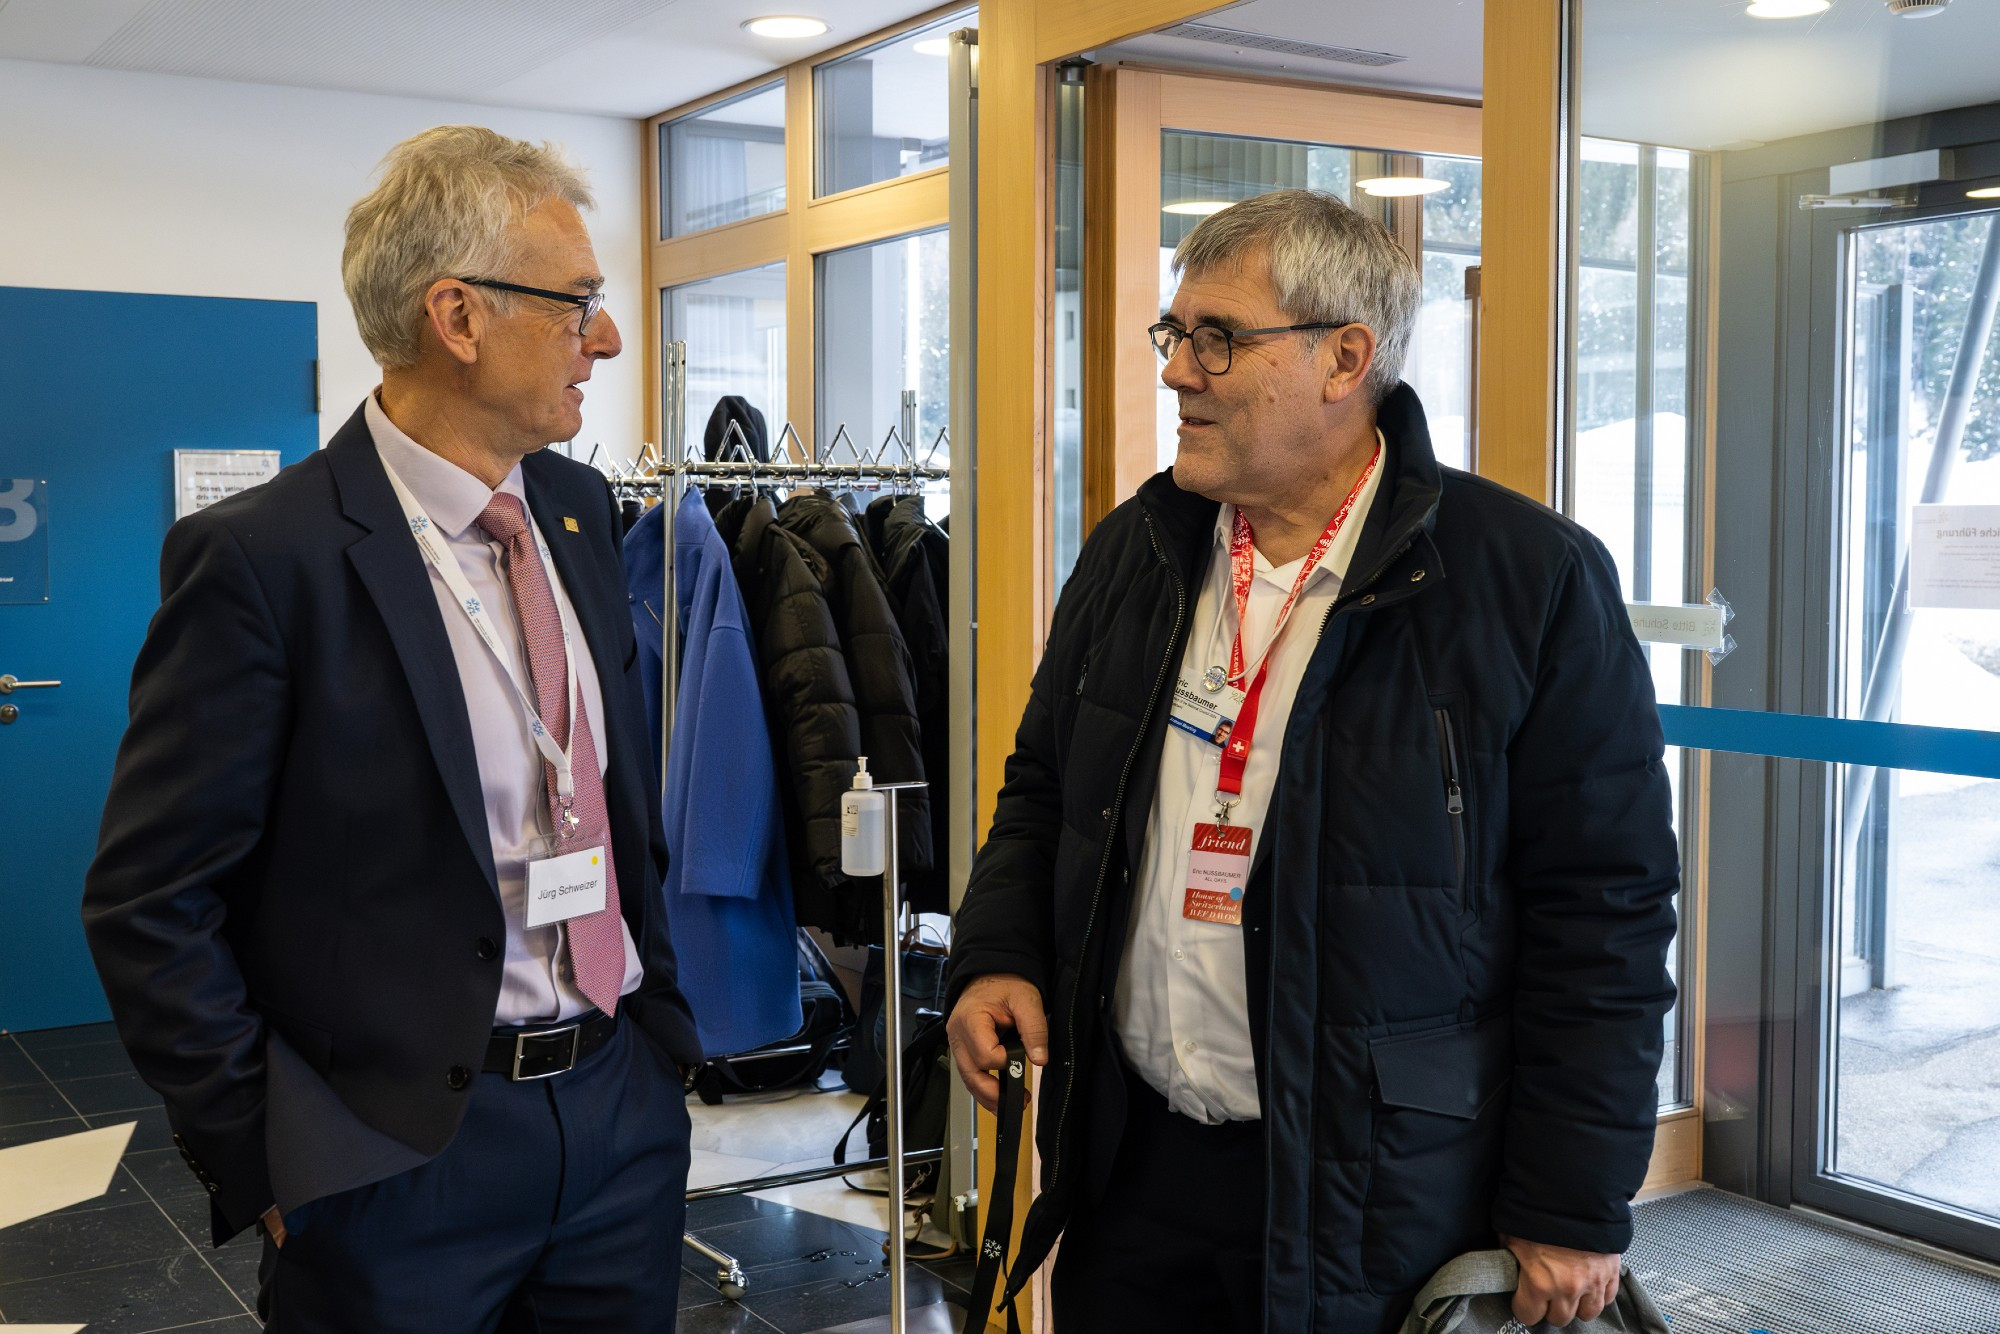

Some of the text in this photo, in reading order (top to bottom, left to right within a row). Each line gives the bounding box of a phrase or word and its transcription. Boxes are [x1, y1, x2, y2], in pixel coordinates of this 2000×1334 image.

[1175, 687, 1218, 710] ussbaumer
[1197, 835, 1246, 850] friend
[537, 879, 598, 900] Jürg Schweizer
[1191, 891, 1215, 901] House
[1191, 900, 1238, 912] Switzerland
